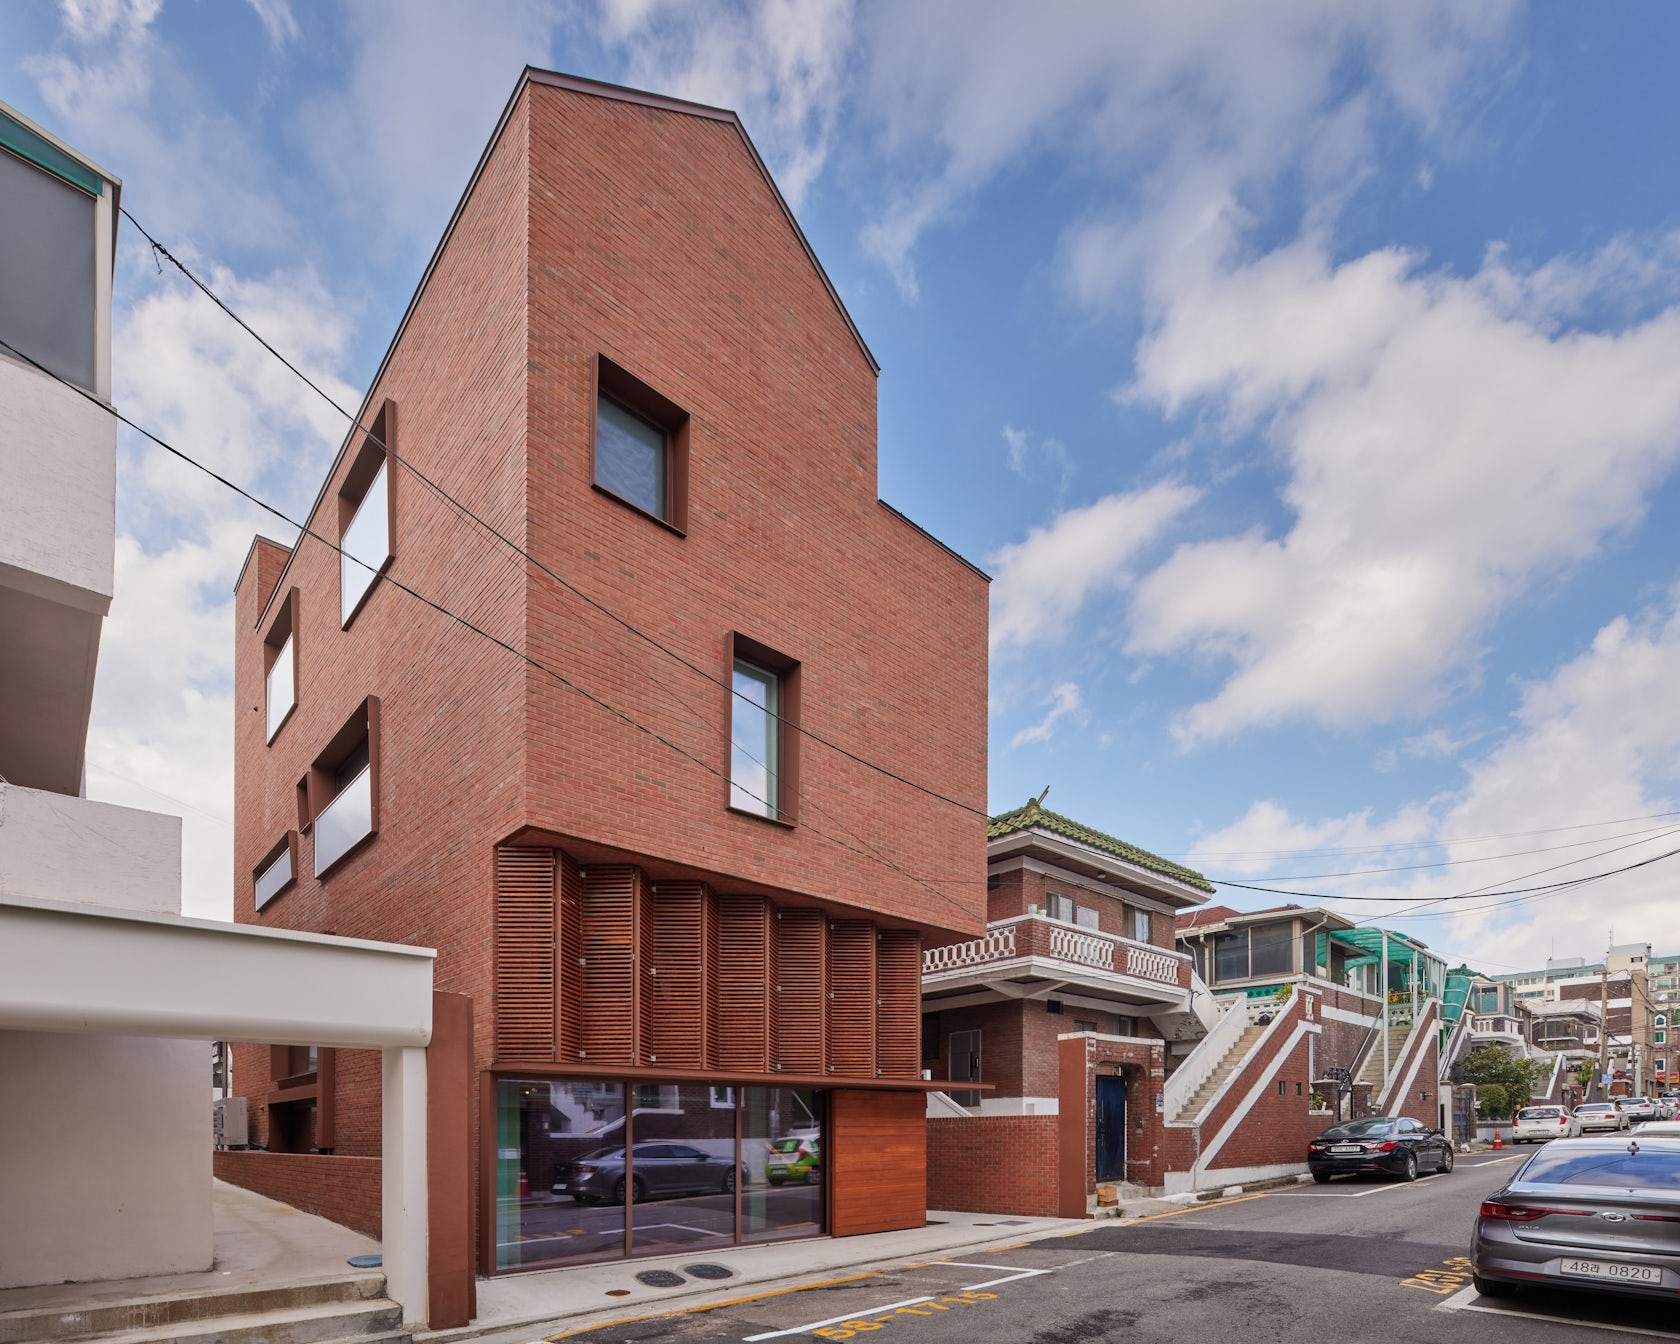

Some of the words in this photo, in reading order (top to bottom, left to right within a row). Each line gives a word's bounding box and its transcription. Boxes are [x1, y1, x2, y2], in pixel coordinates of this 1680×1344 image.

[1570, 1261, 1600, 1274] 48라
[1609, 1265, 1651, 1280] 0820
[812, 1291, 999, 1340] 58-1715
